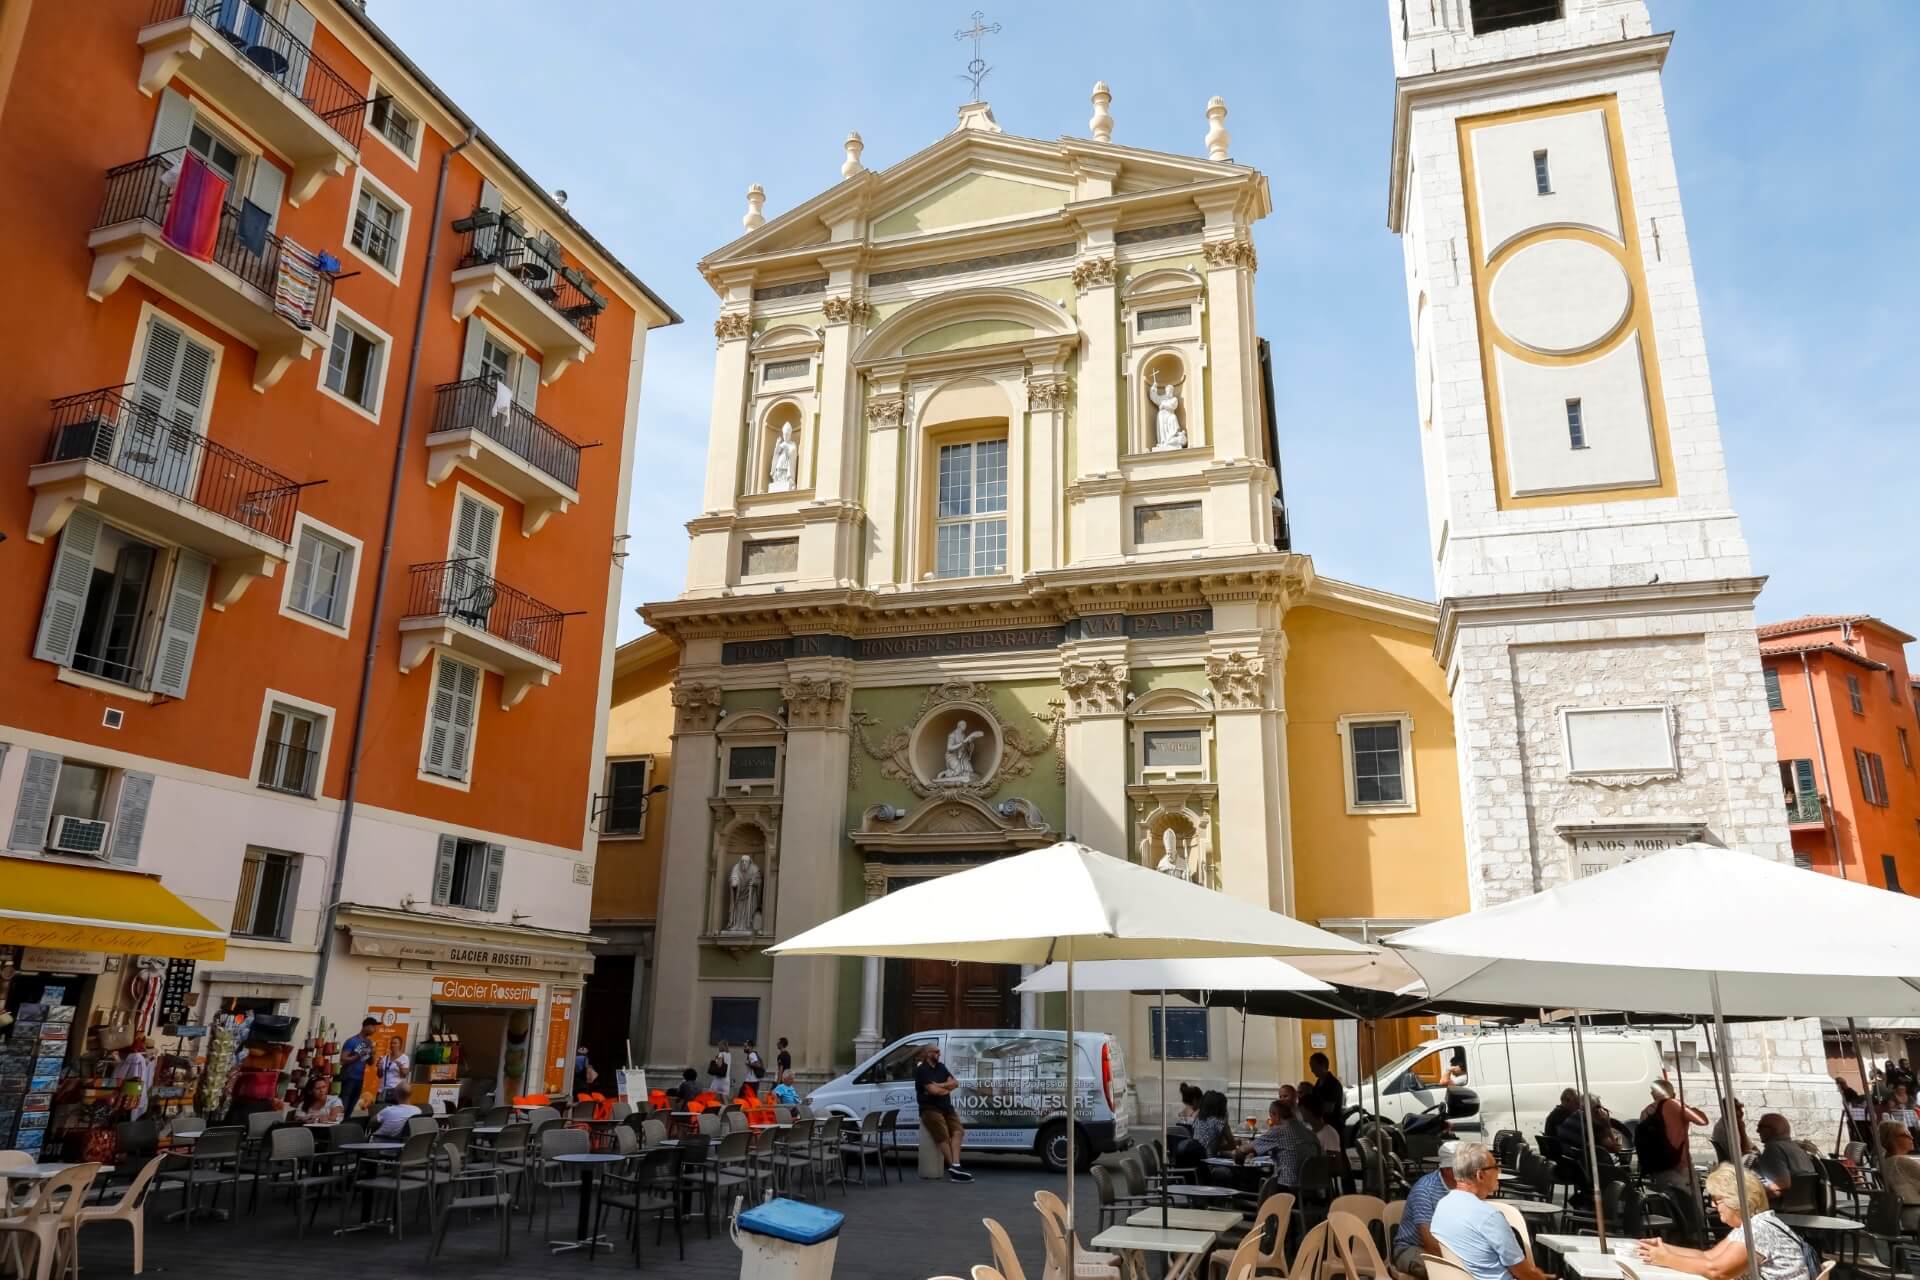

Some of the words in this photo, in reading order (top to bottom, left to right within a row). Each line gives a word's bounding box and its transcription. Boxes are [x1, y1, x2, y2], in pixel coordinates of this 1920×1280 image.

[800, 638, 821, 653] IN
[861, 637, 939, 656] HONOREM
[1582, 840, 1590, 851] A
[1597, 840, 1626, 851] NOS
[450, 948, 489, 962] GLACIER
[491, 952, 532, 967] ROSSETTI
[443, 980, 489, 999] Glacier
[490, 982, 532, 1002] Rossetti
[952, 1095, 988, 1109] INOX
[992, 1095, 1024, 1109] SUR
[1030, 1095, 1094, 1109] MESURE
